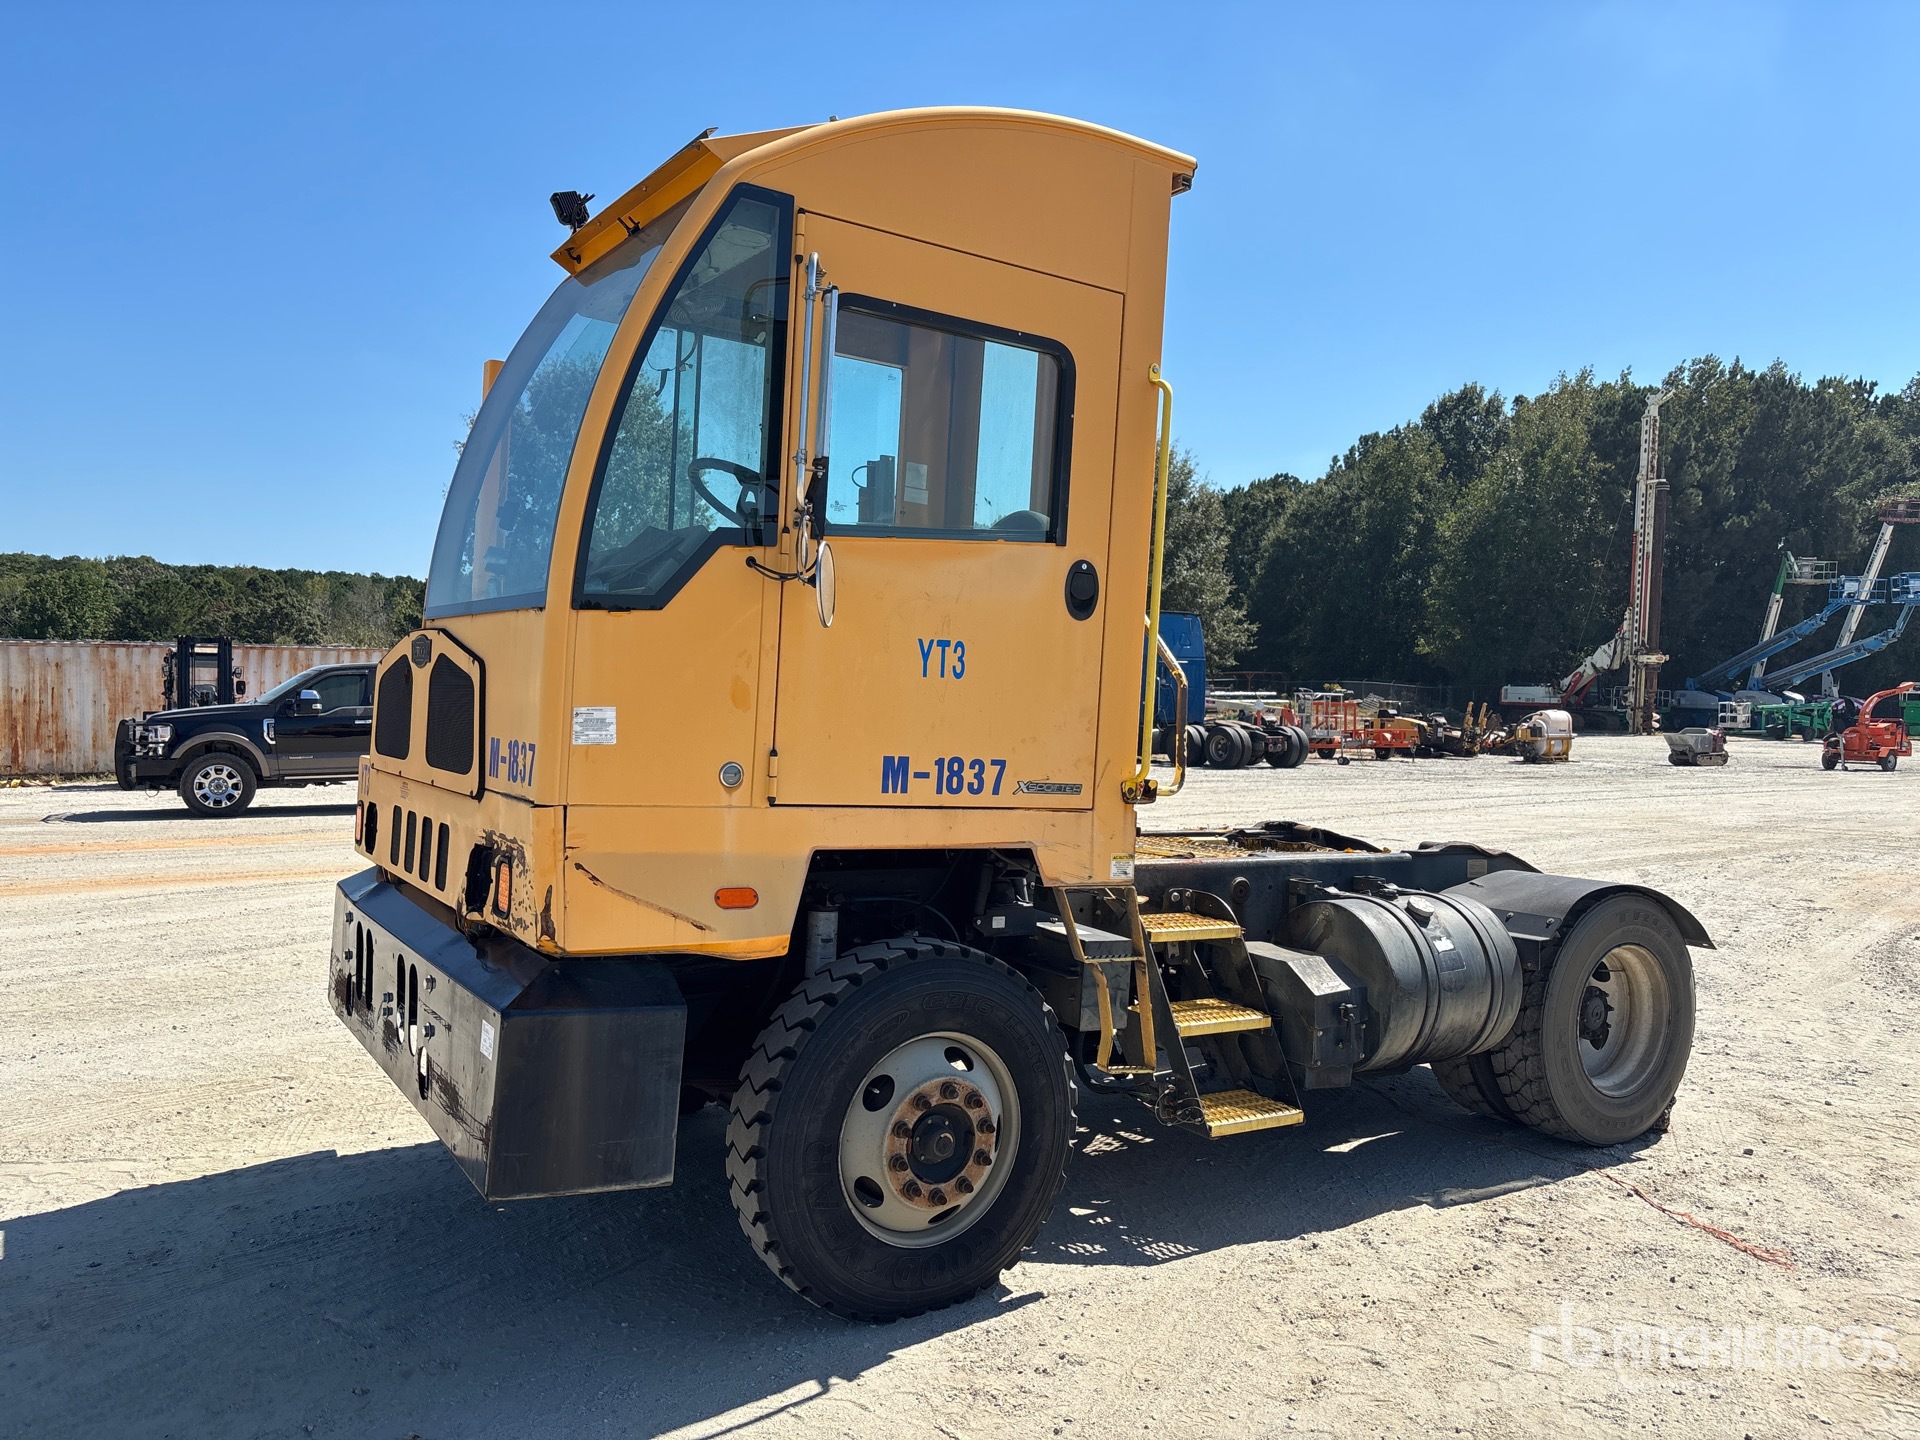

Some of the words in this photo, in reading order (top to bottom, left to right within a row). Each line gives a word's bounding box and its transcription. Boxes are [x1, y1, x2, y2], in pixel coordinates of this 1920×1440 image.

[917, 638, 966, 680] YT3
[488, 736, 536, 787] M-1837
[881, 755, 1007, 796] M-1837
[921, 990, 996, 1017] G316
[805, 1141, 1001, 1290] GOODYEAR
